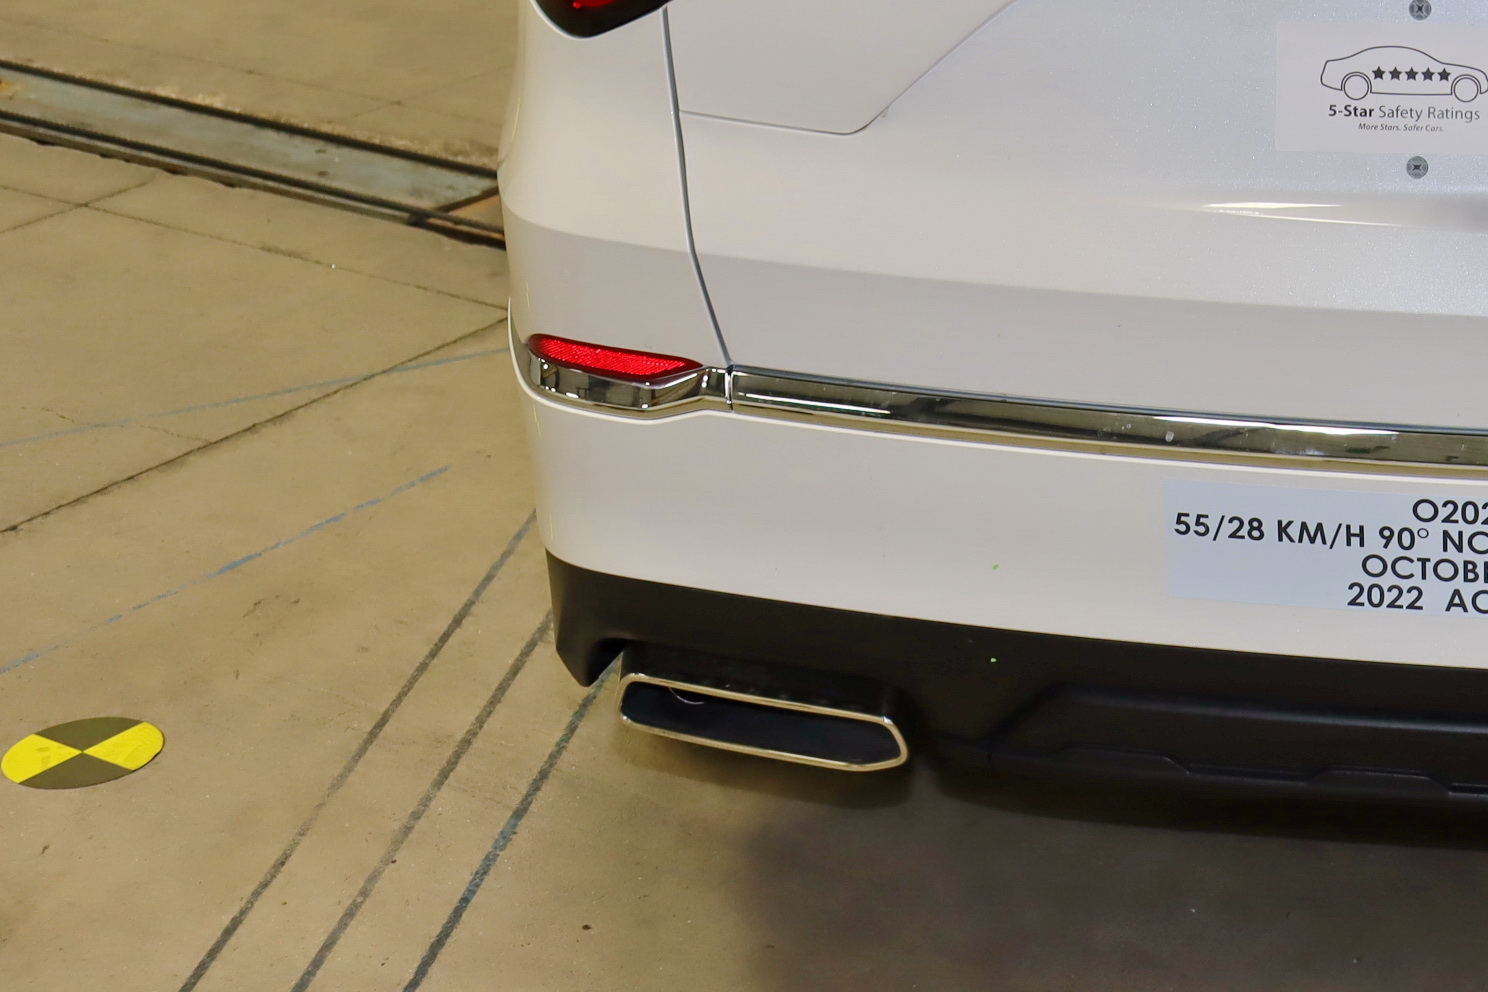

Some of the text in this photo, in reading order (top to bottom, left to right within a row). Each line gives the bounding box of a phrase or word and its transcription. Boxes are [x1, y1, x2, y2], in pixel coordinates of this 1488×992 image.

[1328, 104, 1481, 123] 5-Star Safety Ratings
[1358, 122, 1444, 132] More Stars. Safer Cars.
[1173, 511, 1265, 543] 55/28
[1277, 520, 1365, 549] KM/H
[1378, 526, 1430, 552] 90°
[1347, 581, 1424, 610] 2022
